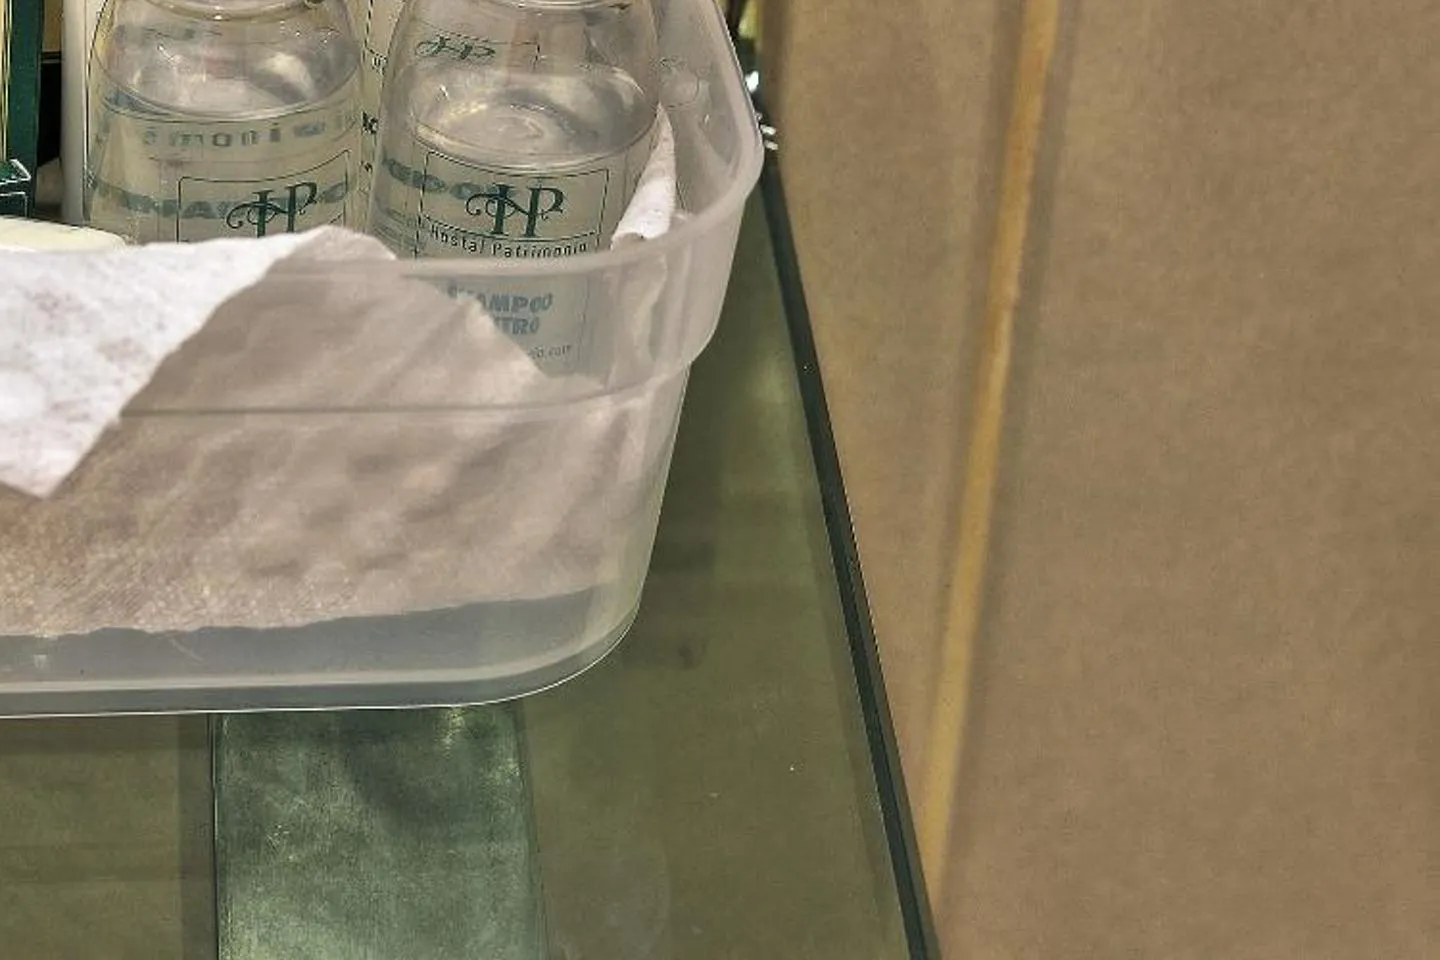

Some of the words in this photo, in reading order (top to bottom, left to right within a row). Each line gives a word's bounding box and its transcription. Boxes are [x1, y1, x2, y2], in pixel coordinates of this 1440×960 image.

[464, 181, 568, 238] HP
[430, 222, 486, 255] Hostal
[490, 240, 588, 259] Patrimonio
